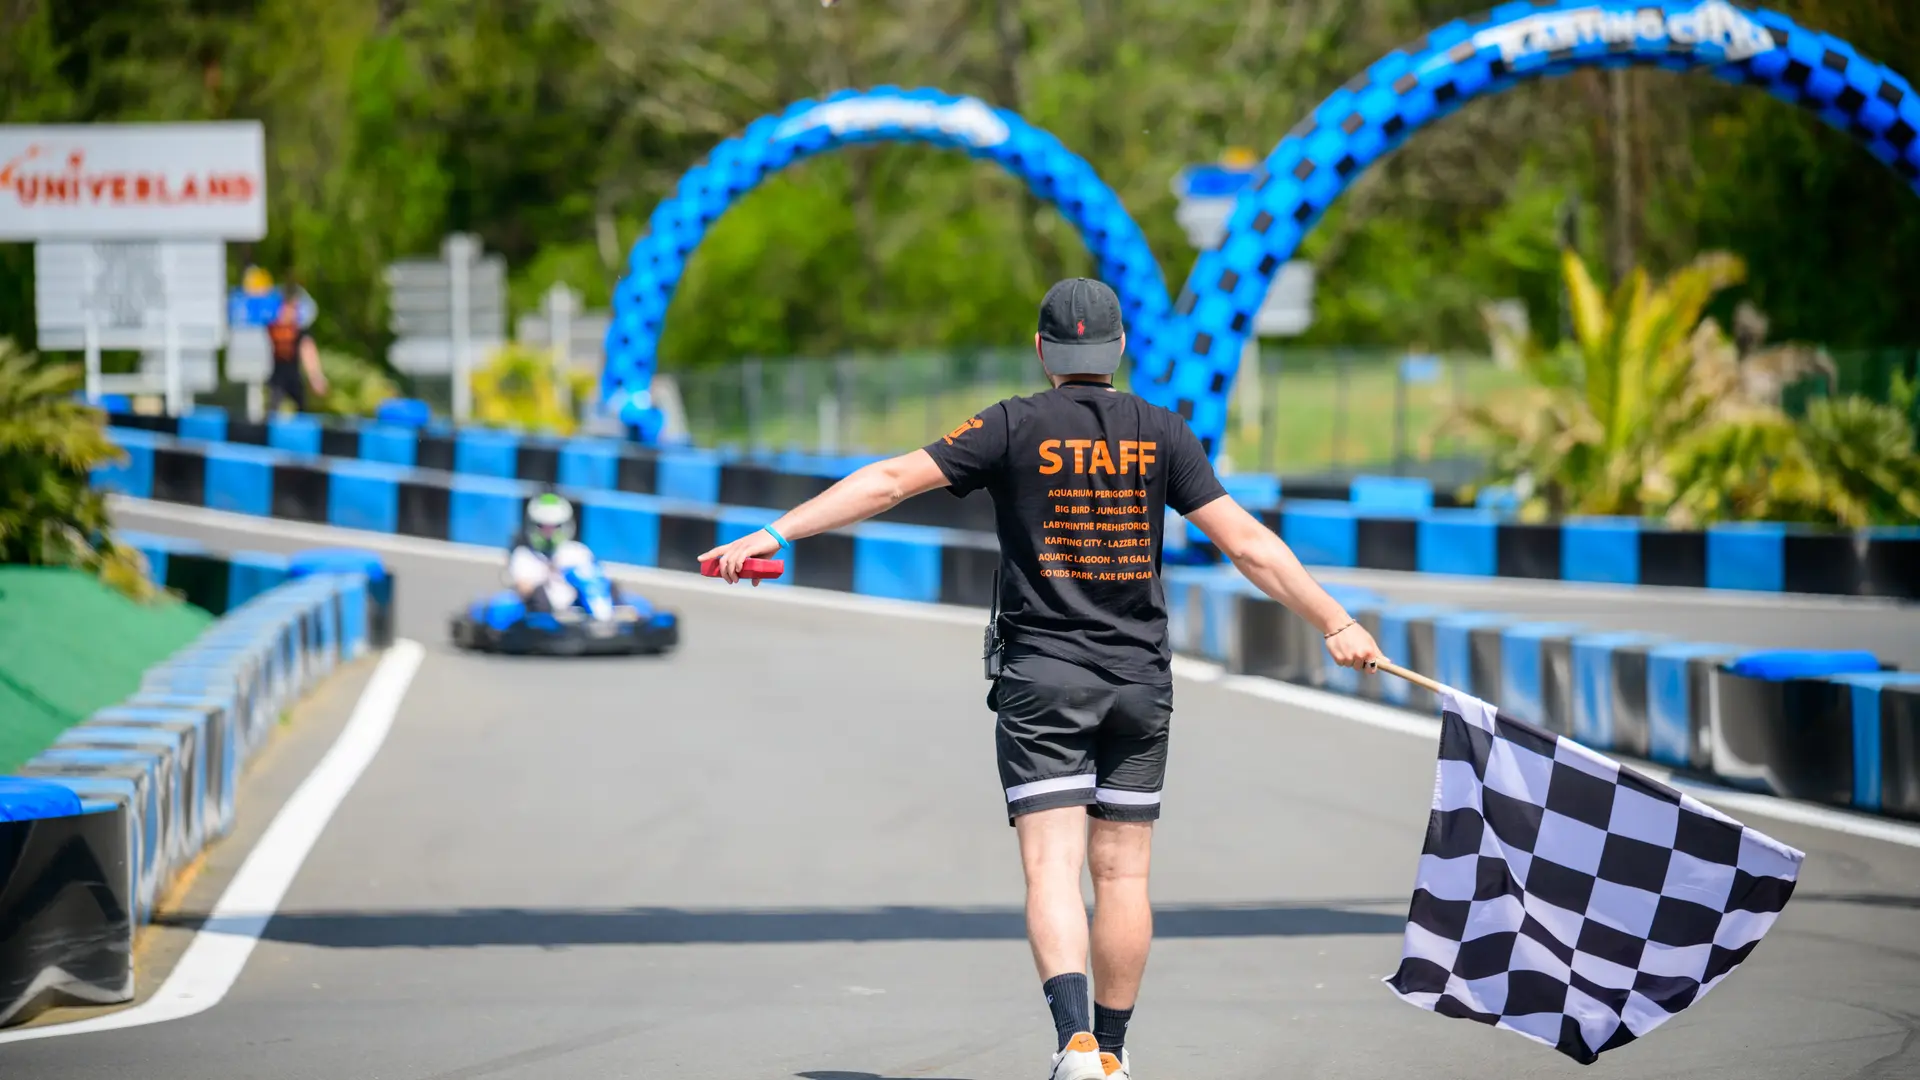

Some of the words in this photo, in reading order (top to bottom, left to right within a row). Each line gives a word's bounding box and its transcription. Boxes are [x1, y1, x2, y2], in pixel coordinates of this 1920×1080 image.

[1038, 439, 1157, 475] STAFF
[1048, 489, 1093, 498] AQUARIUM
[1055, 505, 1069, 513] BIG
[1071, 506, 1090, 514] BIRD
[1096, 506, 1127, 515] JUNGLE
[1127, 506, 1147, 514] GOLF
[1043, 521, 1094, 531] LABYRINTHE
[1045, 537, 1082, 547] KARTING
[1083, 539, 1102, 547] CITY
[1107, 538, 1137, 548] LAZZER
[1038, 553, 1073, 562] AQUATIC
[1074, 555, 1110, 564] LAGOON
[1118, 556, 1129, 564] VR
[1040, 569, 1052, 577] GO
[1052, 569, 1070, 577] KIDS
[1071, 570, 1093, 580] PARK
[1099, 572, 1116, 580] AXE
[1117, 572, 1134, 580] FUN
